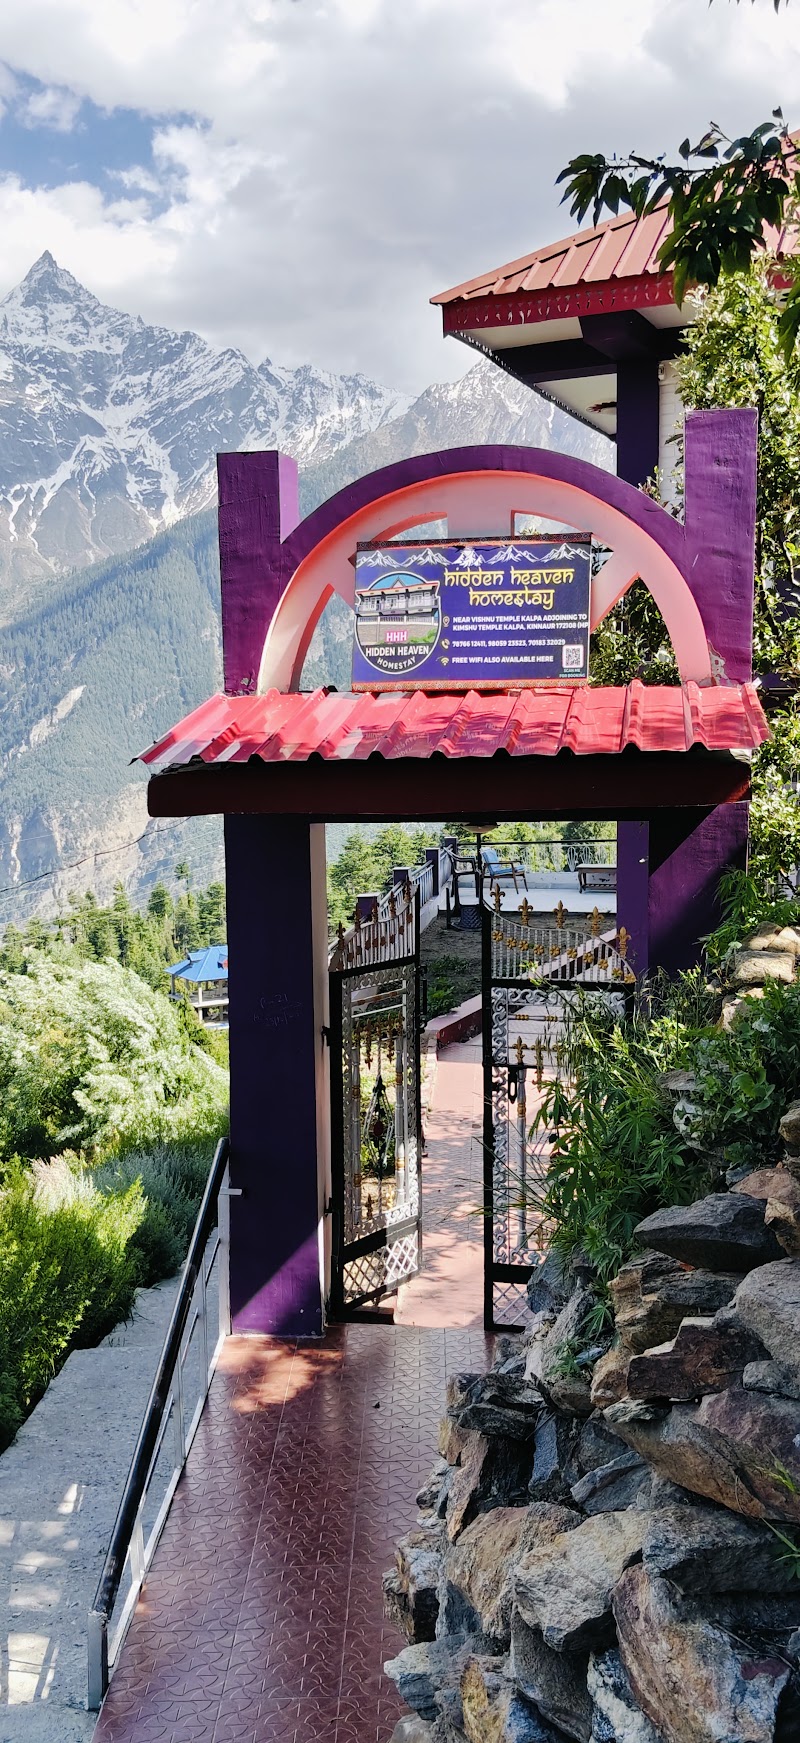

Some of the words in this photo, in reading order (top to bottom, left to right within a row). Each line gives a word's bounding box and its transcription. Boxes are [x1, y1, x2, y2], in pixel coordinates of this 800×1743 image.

[443, 567, 504, 586] hidden
[510, 566, 575, 585] heaven
[468, 585, 555, 610] homestay
[386, 631, 407, 642] HHH
[366, 647, 395, 657] HIDDEN
[397, 646, 429, 656] HEAVEN
[377, 656, 416, 670] HOMESTAY
